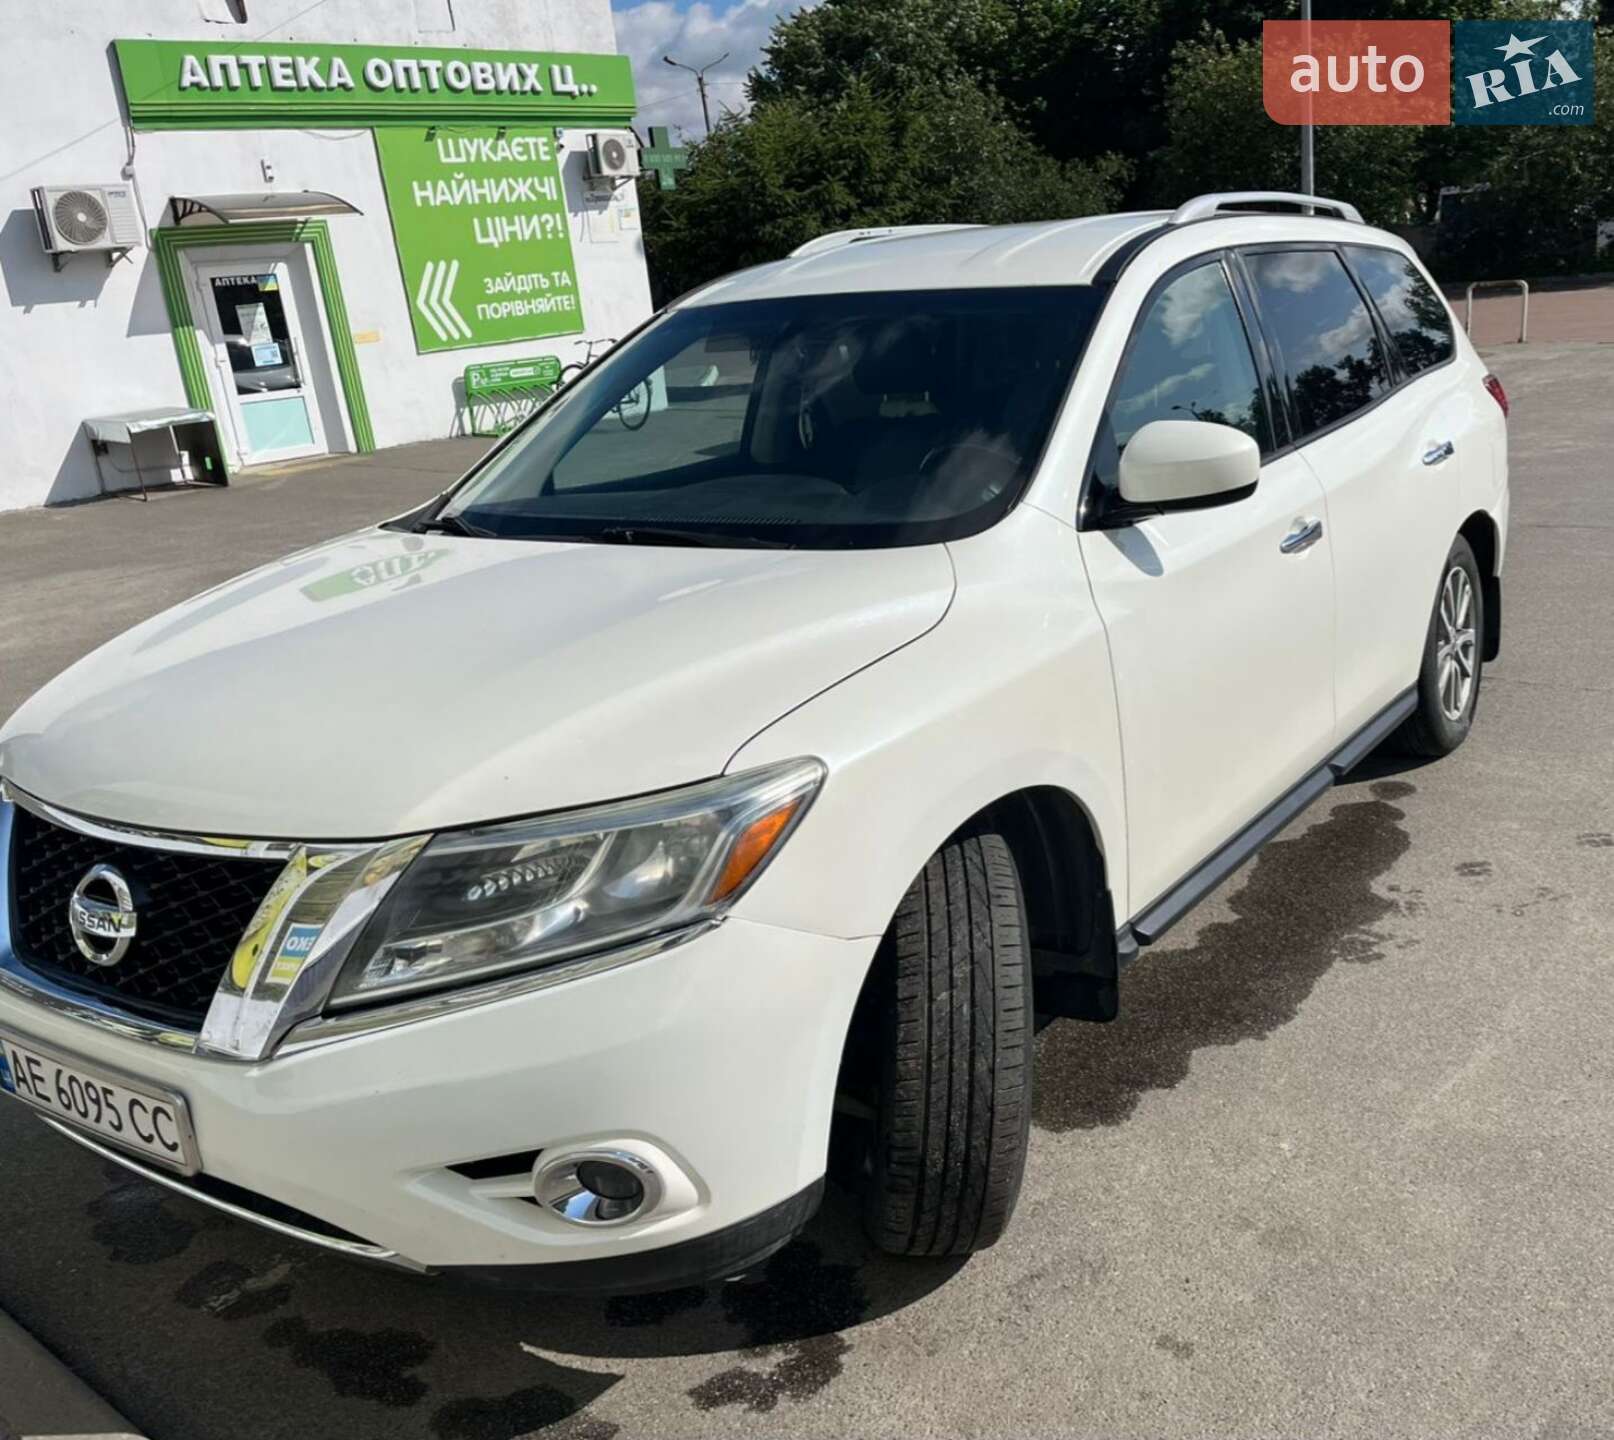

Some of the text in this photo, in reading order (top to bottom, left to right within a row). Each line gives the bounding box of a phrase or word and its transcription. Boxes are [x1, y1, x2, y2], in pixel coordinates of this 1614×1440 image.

[180, 54, 355, 91] АПТЕКА
[363, 57, 544, 93] ОПТОВИХ
[437, 136, 552, 164] ШУКАЄТЕ
[413, 172, 558, 207] НАЙНИЖЧІ
[473, 213, 565, 248] ЦІНИ?!
[215, 275, 257, 287] АПТЕКА
[484, 270, 572, 295] ЗАЙДІТЬ ТА
[476, 293, 577, 321] ПОРІВНЯЙТЕ!
[11, 1050, 179, 1152] AE 6095 CC
